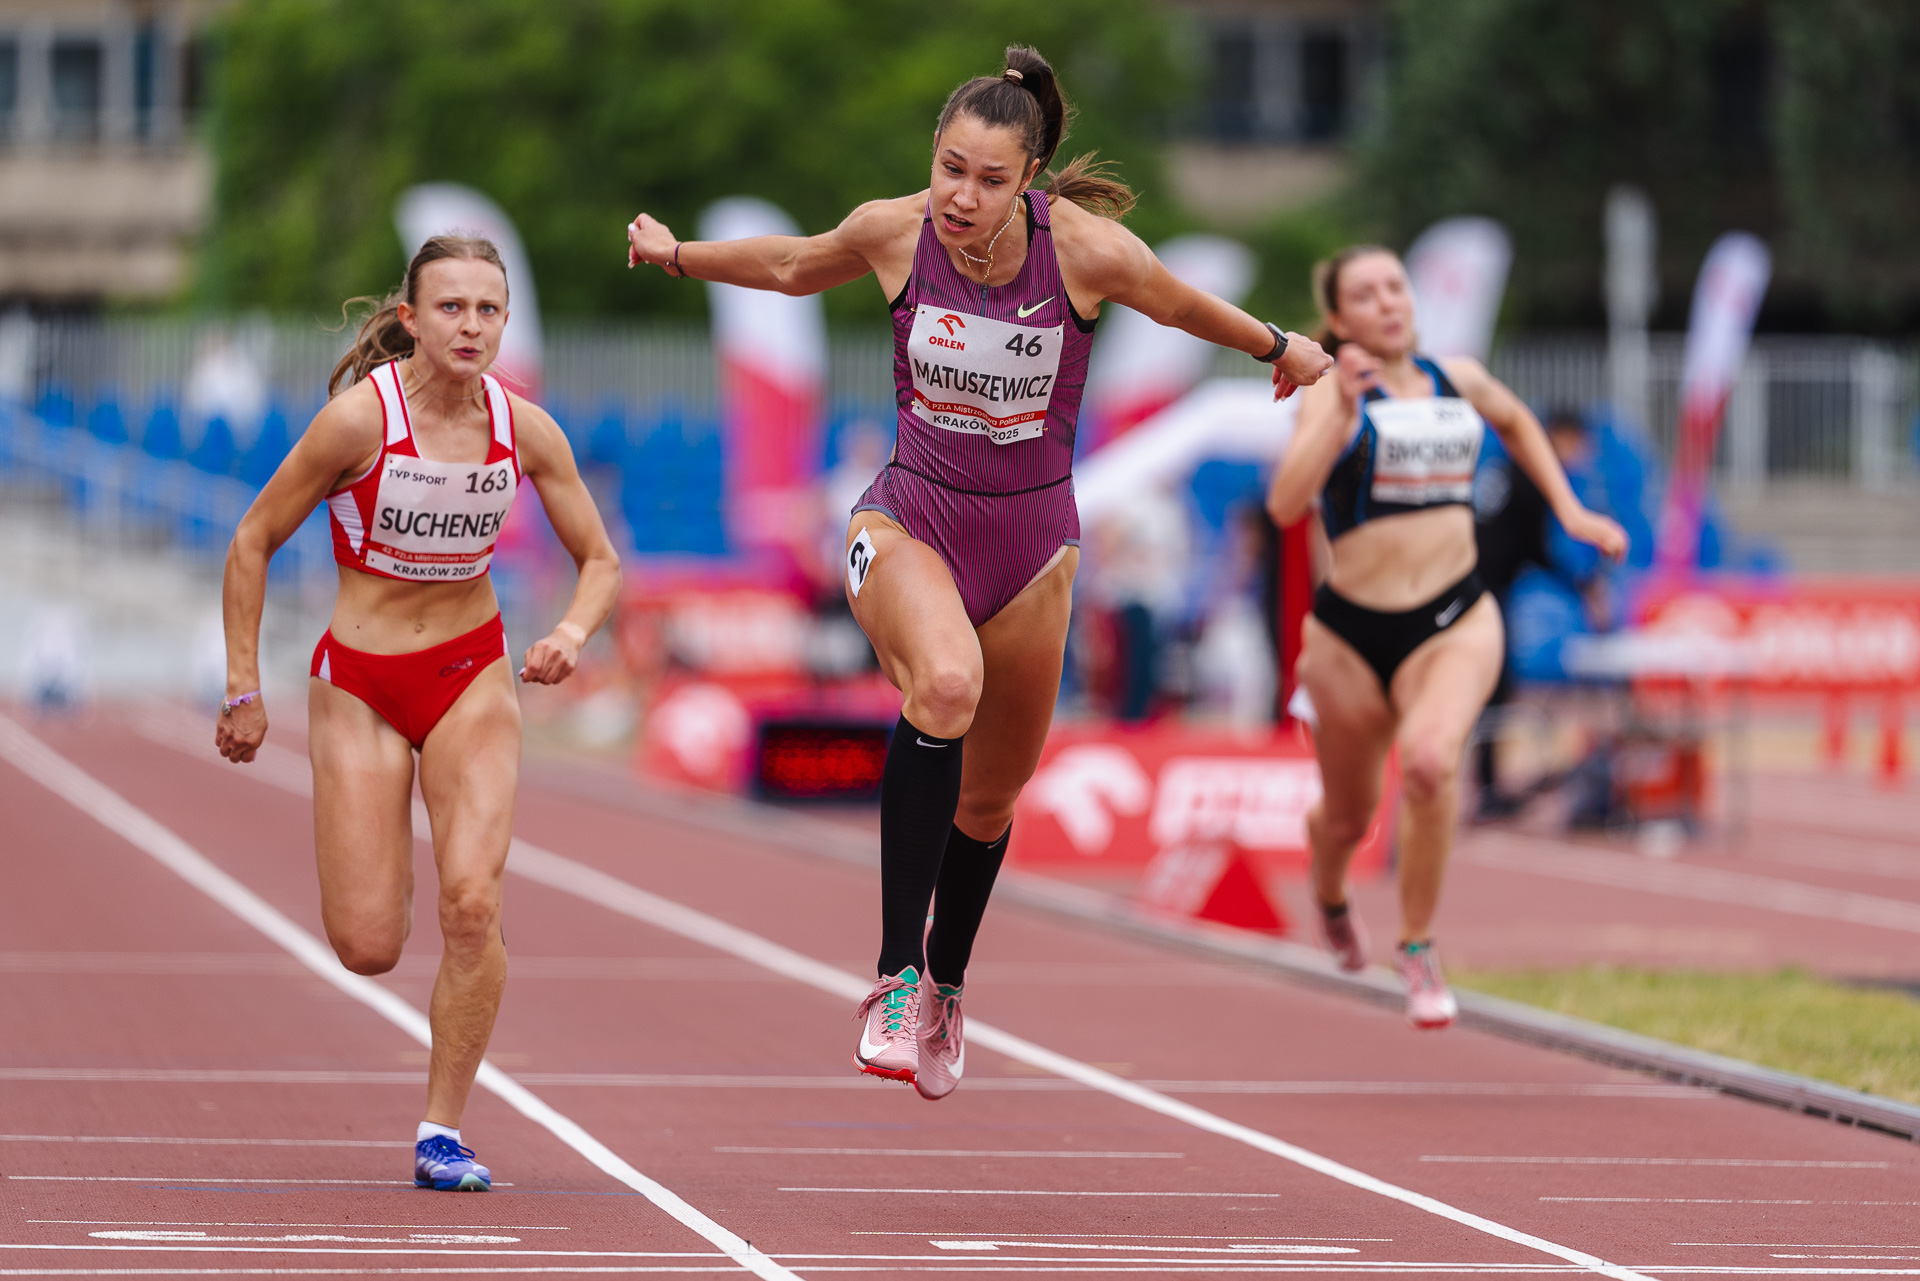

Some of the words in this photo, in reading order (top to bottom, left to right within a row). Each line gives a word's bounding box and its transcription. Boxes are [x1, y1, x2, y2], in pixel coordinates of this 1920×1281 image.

[929, 336, 966, 351] ORLEN
[1005, 333, 1043, 357] 46
[914, 358, 1053, 402] MATUSZEWICZ
[932, 403, 952, 412] PZLA
[953, 405, 997, 426] Mistrzostwa
[999, 415, 1020, 426] Polski
[1021, 413, 1035, 422] U23
[933, 415, 991, 434] KRAKÓW
[991, 428, 1019, 441] 2025
[388, 469, 410, 481] TVP
[412, 473, 447, 486] SPORT
[465, 469, 508, 494] 163
[379, 507, 506, 538] SUCHENEK
[395, 551, 414, 561] PZLA
[414, 554, 459, 562] Mistrzostwa
[851, 542, 868, 585] 2
[393, 563, 450, 577] KRAKÓW
